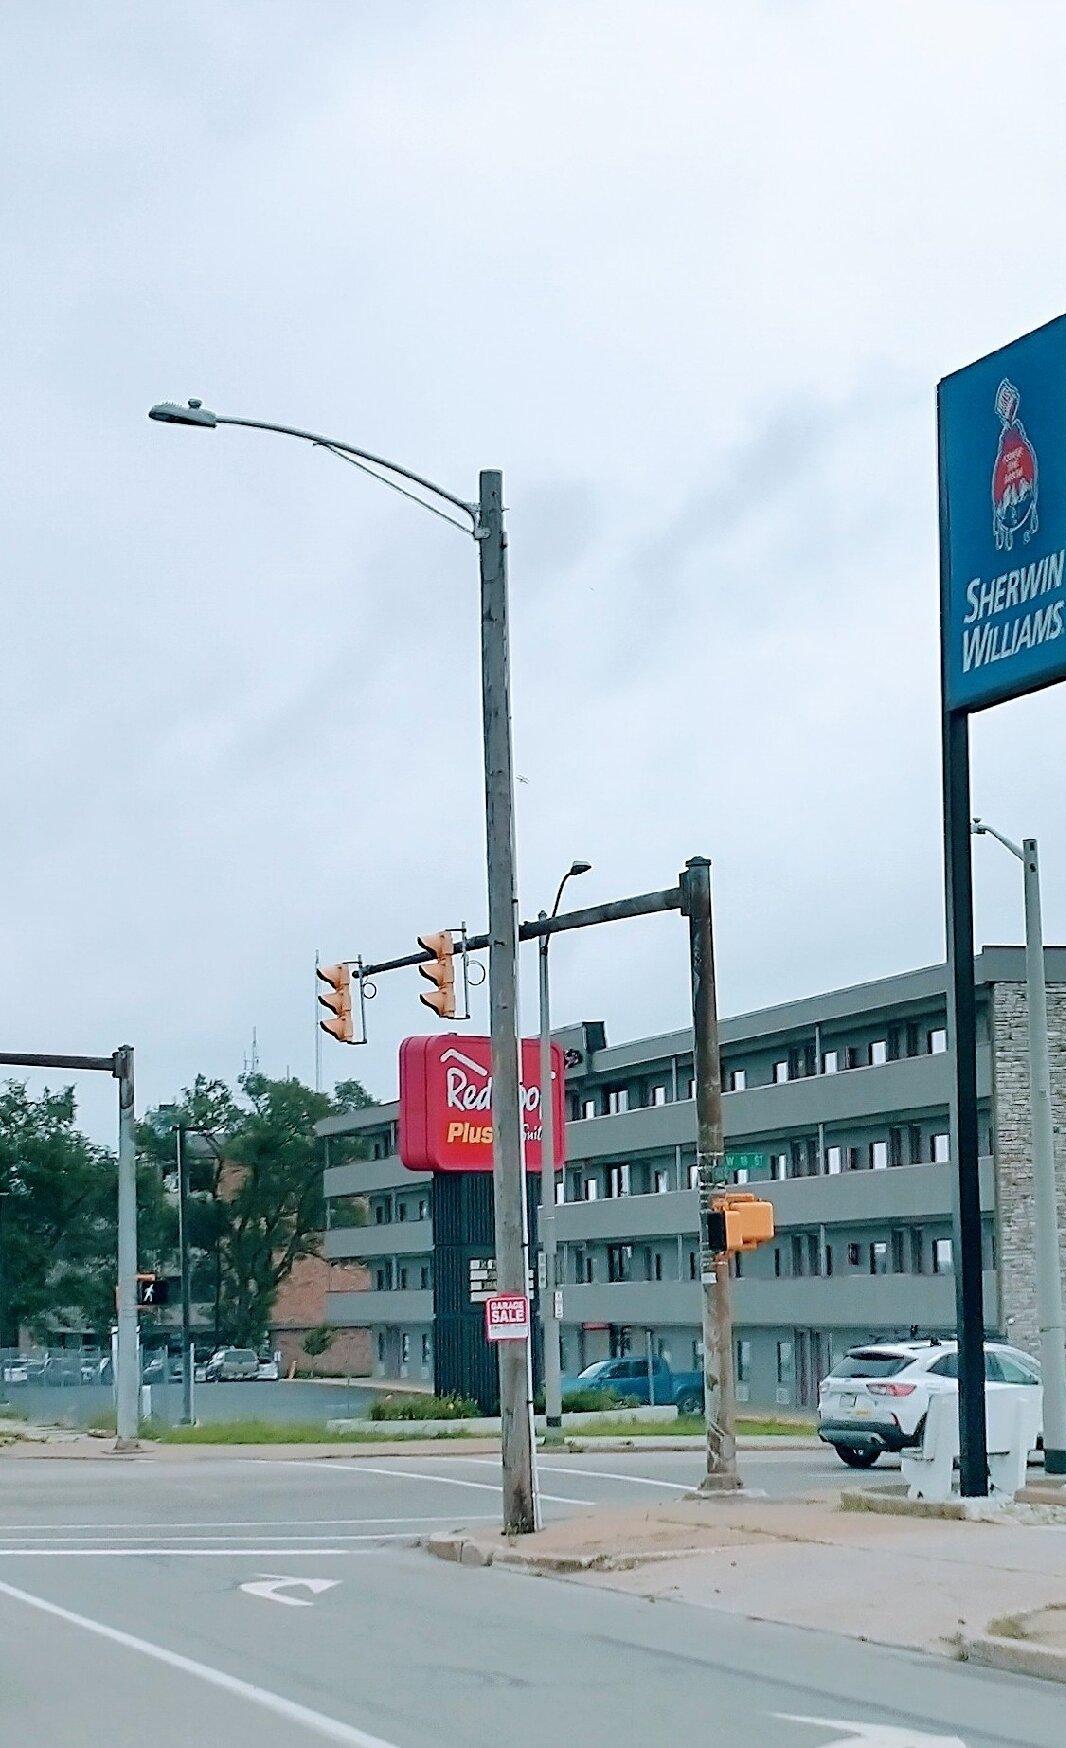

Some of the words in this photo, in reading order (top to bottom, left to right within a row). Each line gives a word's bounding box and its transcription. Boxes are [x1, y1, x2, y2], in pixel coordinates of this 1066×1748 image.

[963, 550, 1065, 624] SHERWIN
[962, 601, 1065, 672] WILLIAMS
[446, 1067, 493, 1111] Red
[491, 1301, 525, 1311] GARAGE
[491, 1310, 525, 1323] SALE
